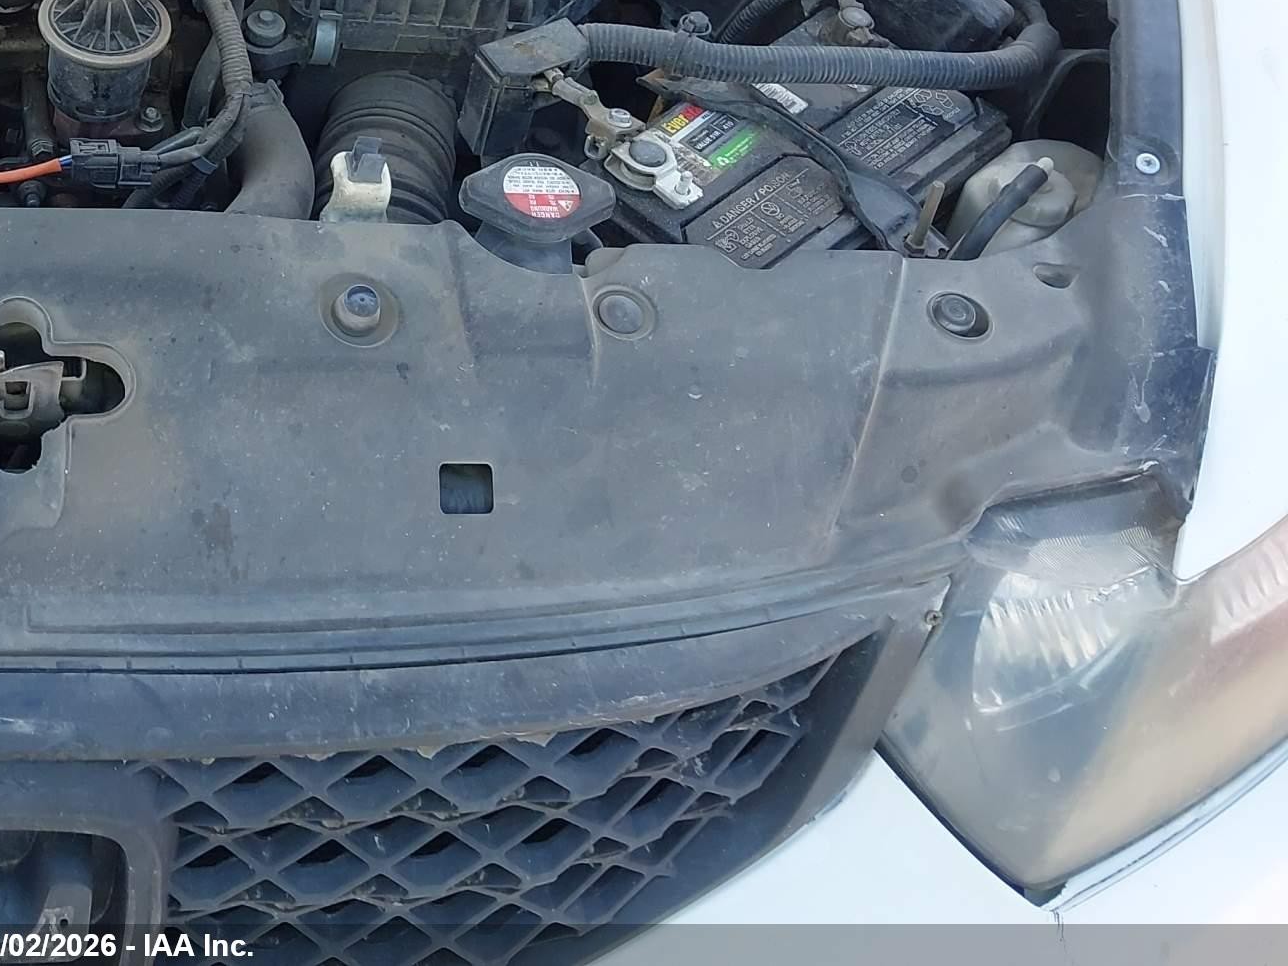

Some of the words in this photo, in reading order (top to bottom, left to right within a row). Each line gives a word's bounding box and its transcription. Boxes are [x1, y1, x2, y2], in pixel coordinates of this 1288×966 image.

[695, 135, 713, 151] VALUE
[719, 196, 755, 223] DANGER
[758, 172, 792, 198] POISON
